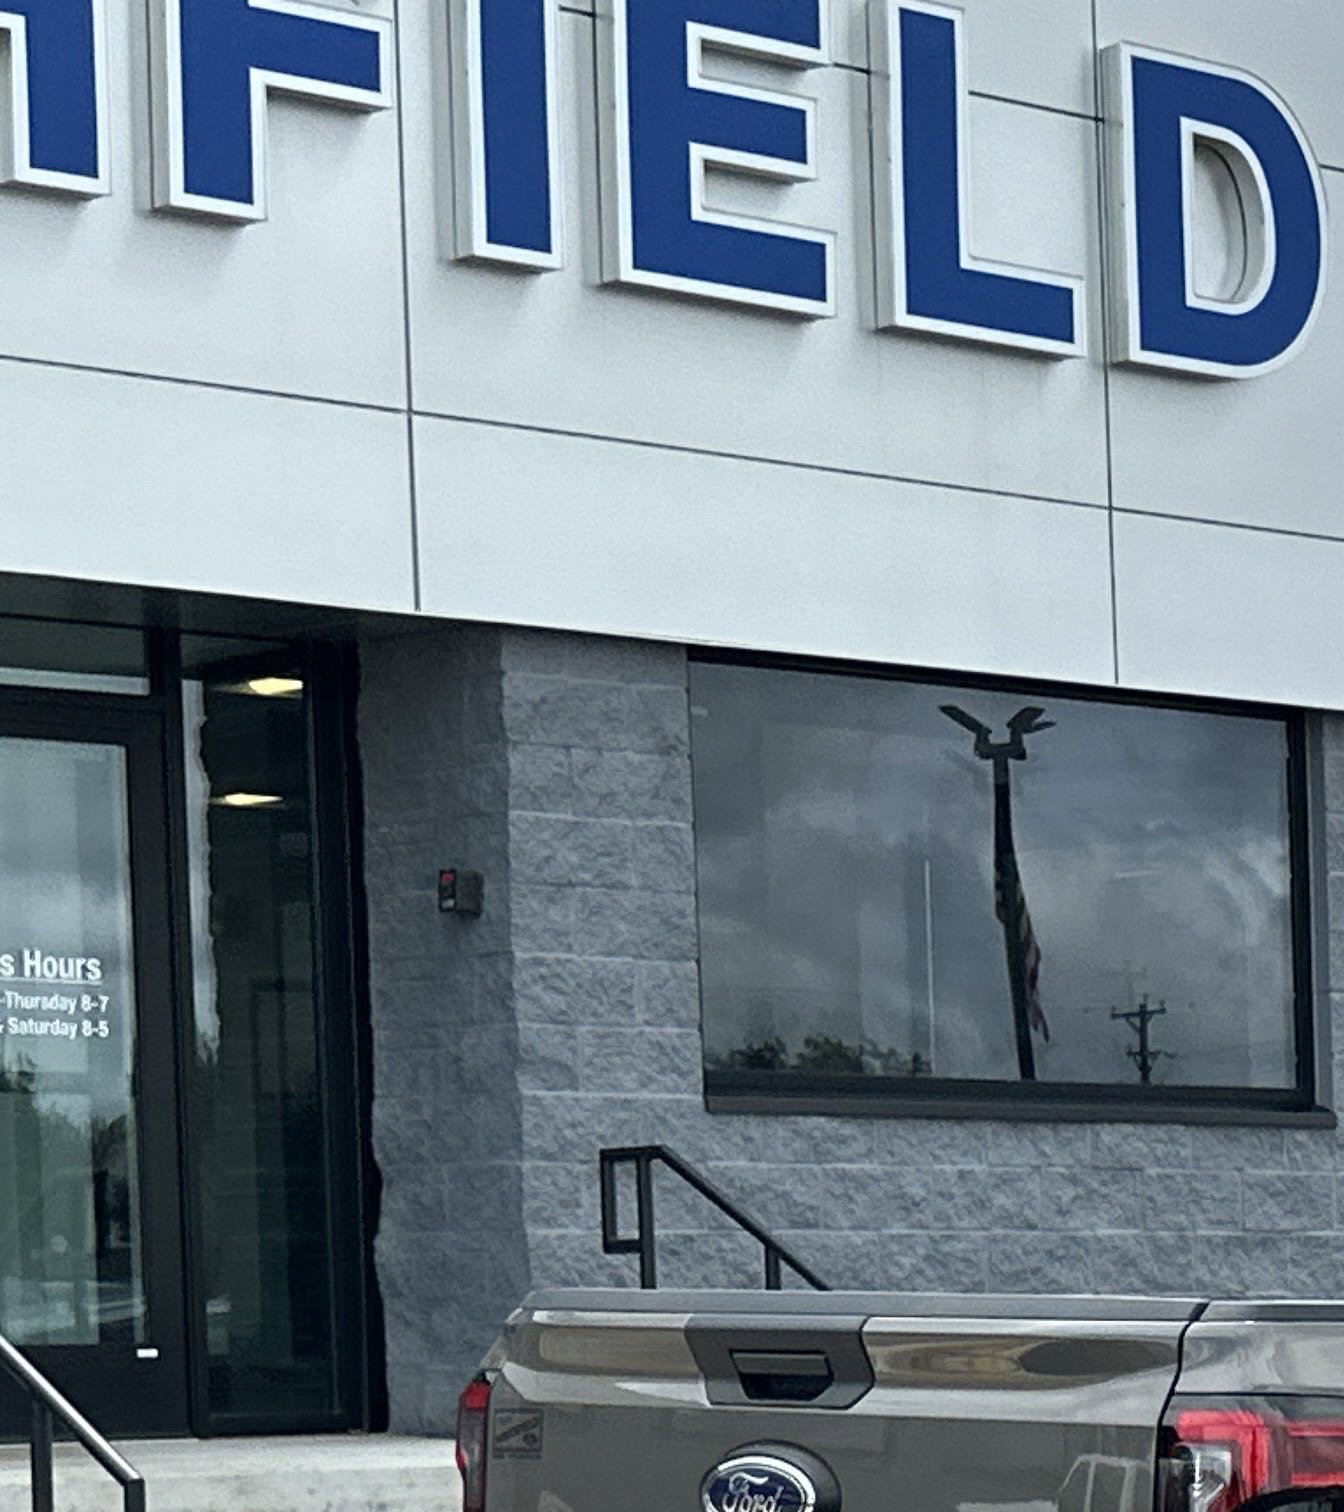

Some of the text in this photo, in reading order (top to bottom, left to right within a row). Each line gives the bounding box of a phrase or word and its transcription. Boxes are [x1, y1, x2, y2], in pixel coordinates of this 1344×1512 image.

[23, 949, 102, 980] Hours
[81, 994, 110, 1013] 8-7
[7, 1017, 110, 1040] Saturday 8-5
